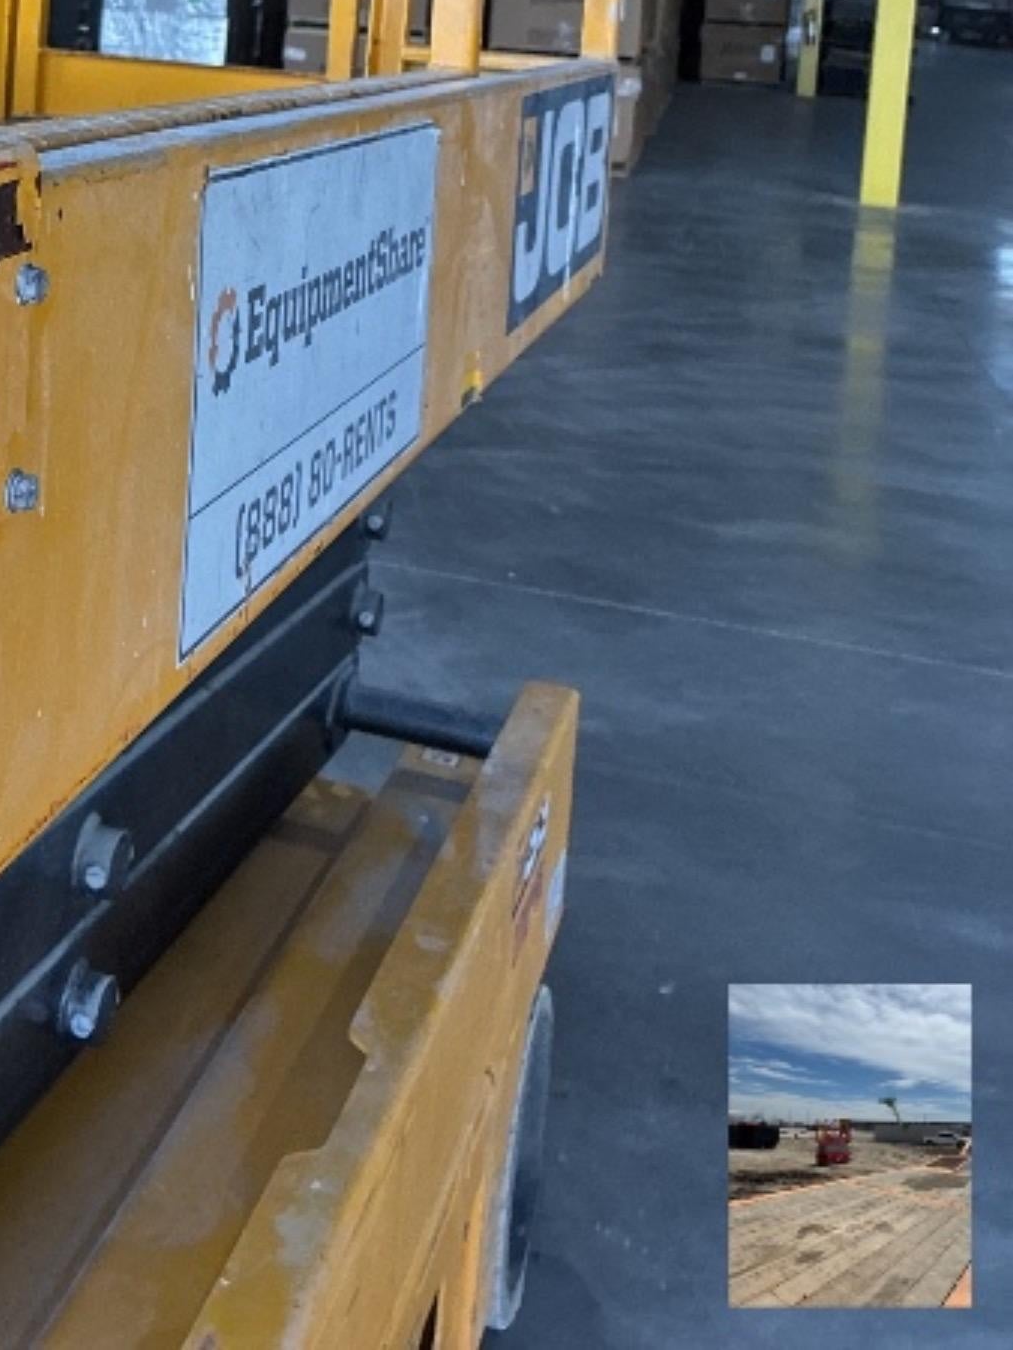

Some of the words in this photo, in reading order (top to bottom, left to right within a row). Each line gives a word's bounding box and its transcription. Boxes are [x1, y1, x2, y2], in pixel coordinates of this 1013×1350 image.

[514, 91, 610, 304] JCB
[244, 226, 426, 367] EquipmentShare
[235, 462, 303, 579] (888)
[308, 389, 397, 508] 80-RENTS
